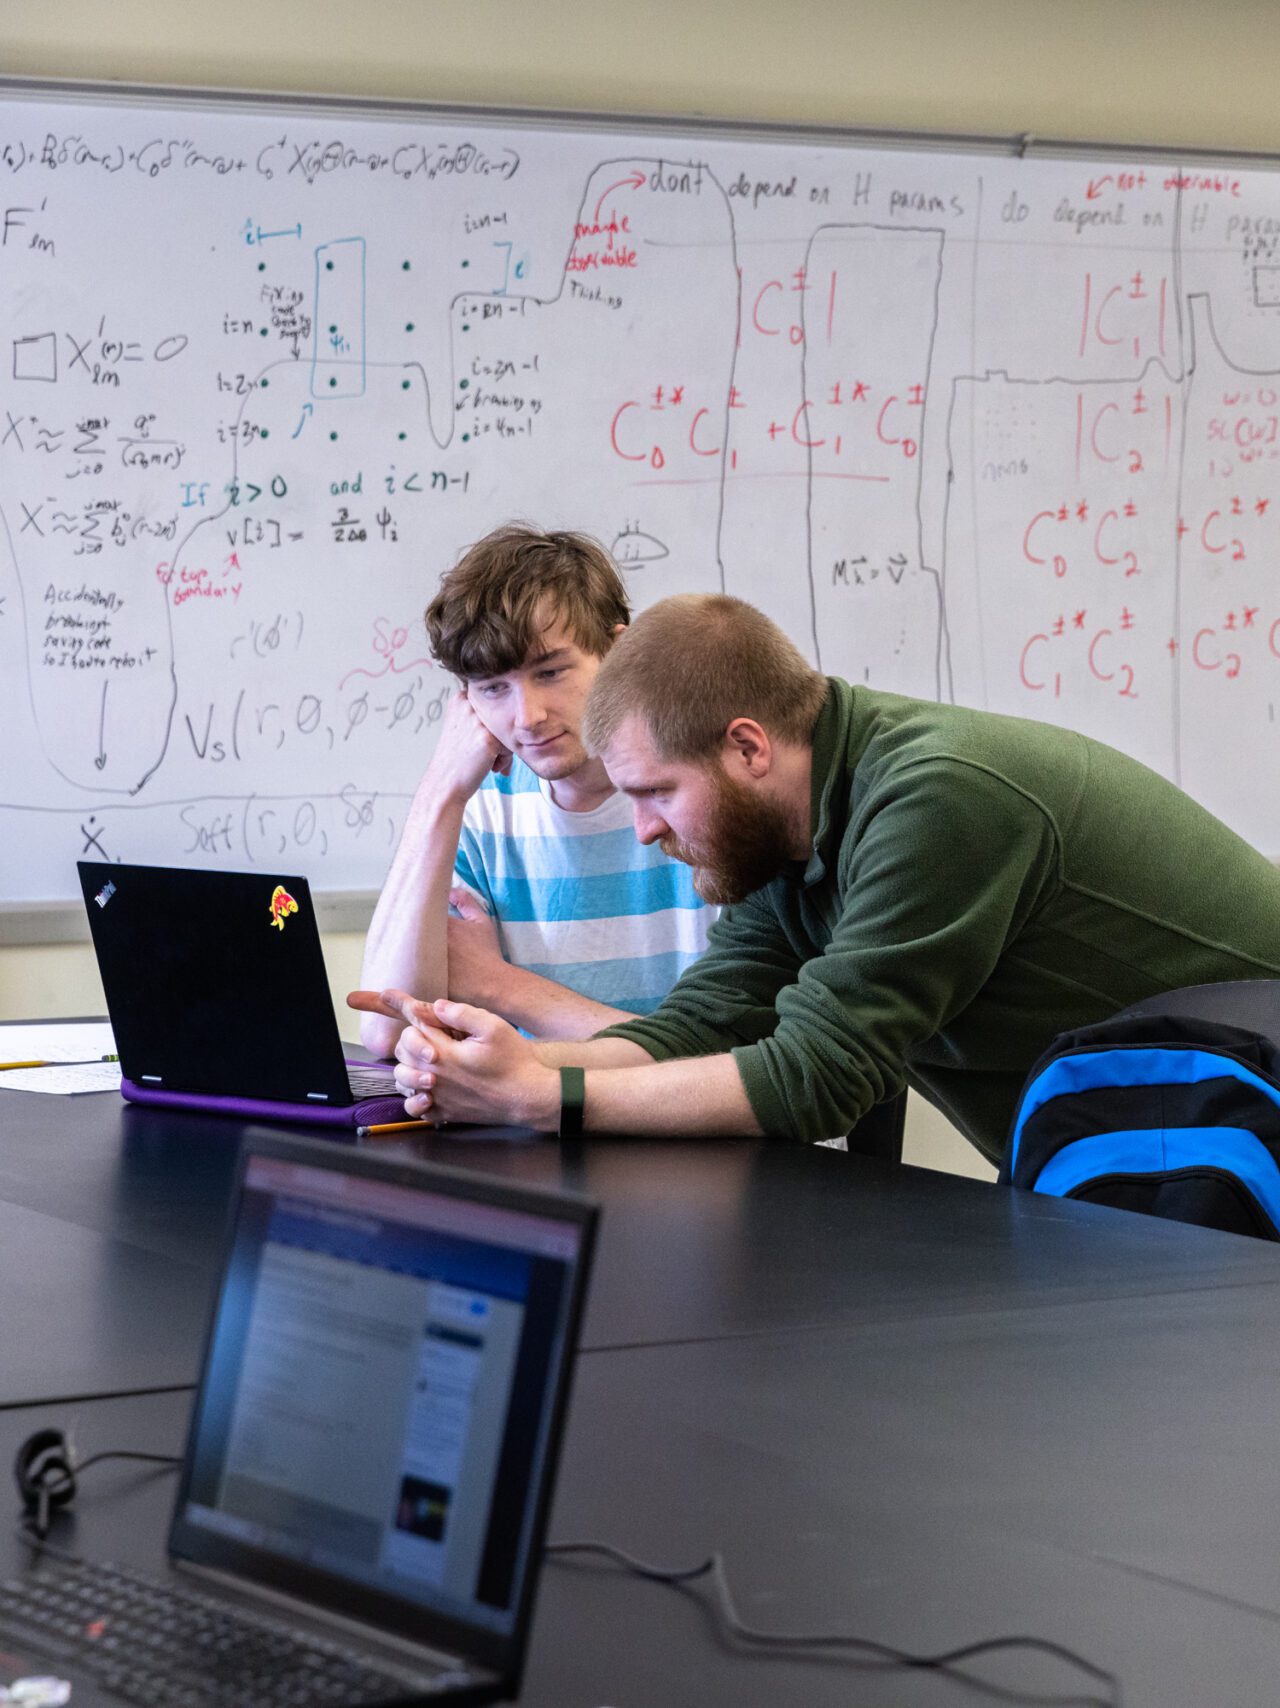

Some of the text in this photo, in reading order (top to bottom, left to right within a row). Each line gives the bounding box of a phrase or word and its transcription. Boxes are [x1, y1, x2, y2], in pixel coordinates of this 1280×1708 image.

[728, 172, 798, 210] depend
[809, 186, 830, 205] on
[854, 172, 872, 206] H
[889, 187, 966, 218] params
[1001, 189, 1029, 223] do
[1053, 197, 1127, 235] depend
[1142, 211, 1163, 227] on
[331, 471, 363, 497] and
